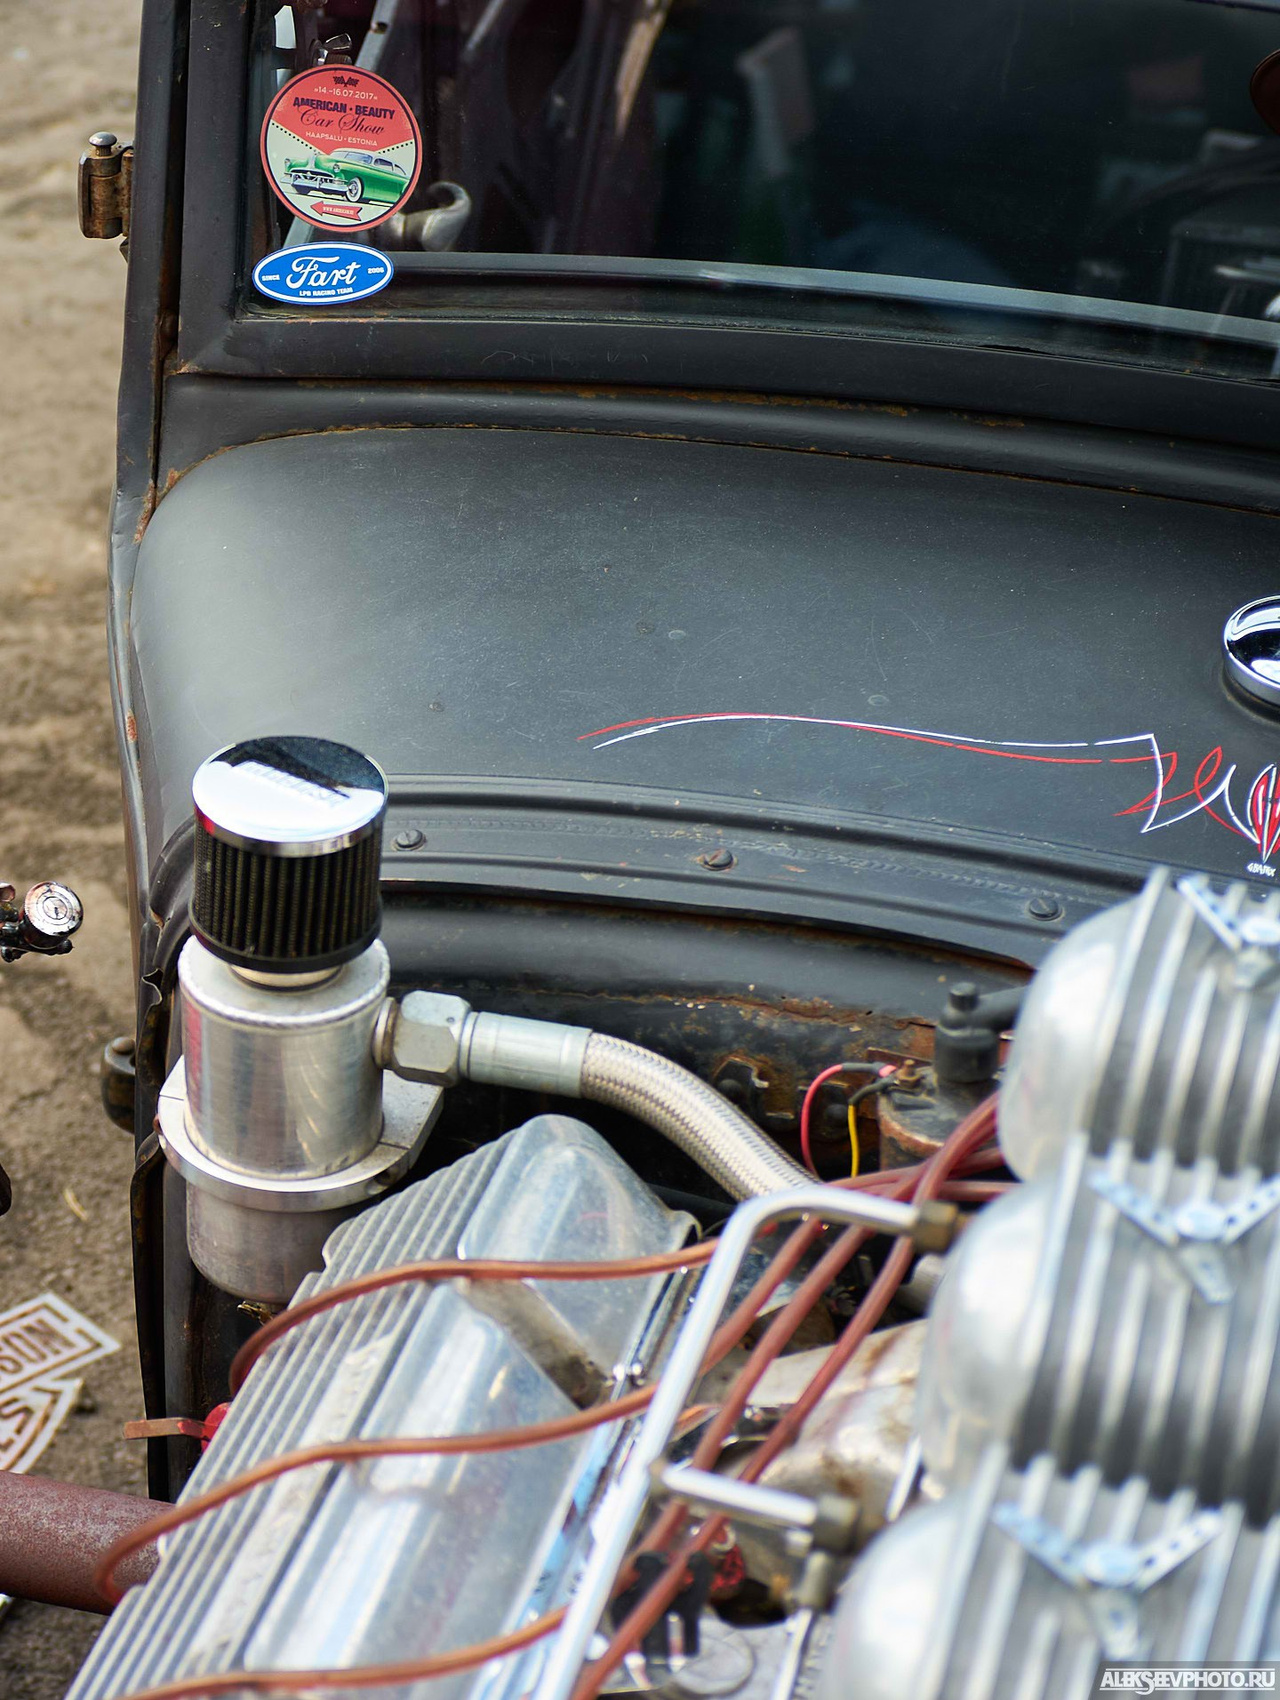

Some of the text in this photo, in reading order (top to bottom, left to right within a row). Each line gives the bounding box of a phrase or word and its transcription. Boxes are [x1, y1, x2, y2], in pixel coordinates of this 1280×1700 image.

[293, 97, 395, 120] AMERICAN BEAUTY
[298, 105, 385, 135] Car Show
[306, 131, 378, 147] HAAPSALU ESTONIA
[285, 256, 361, 289] Fart
